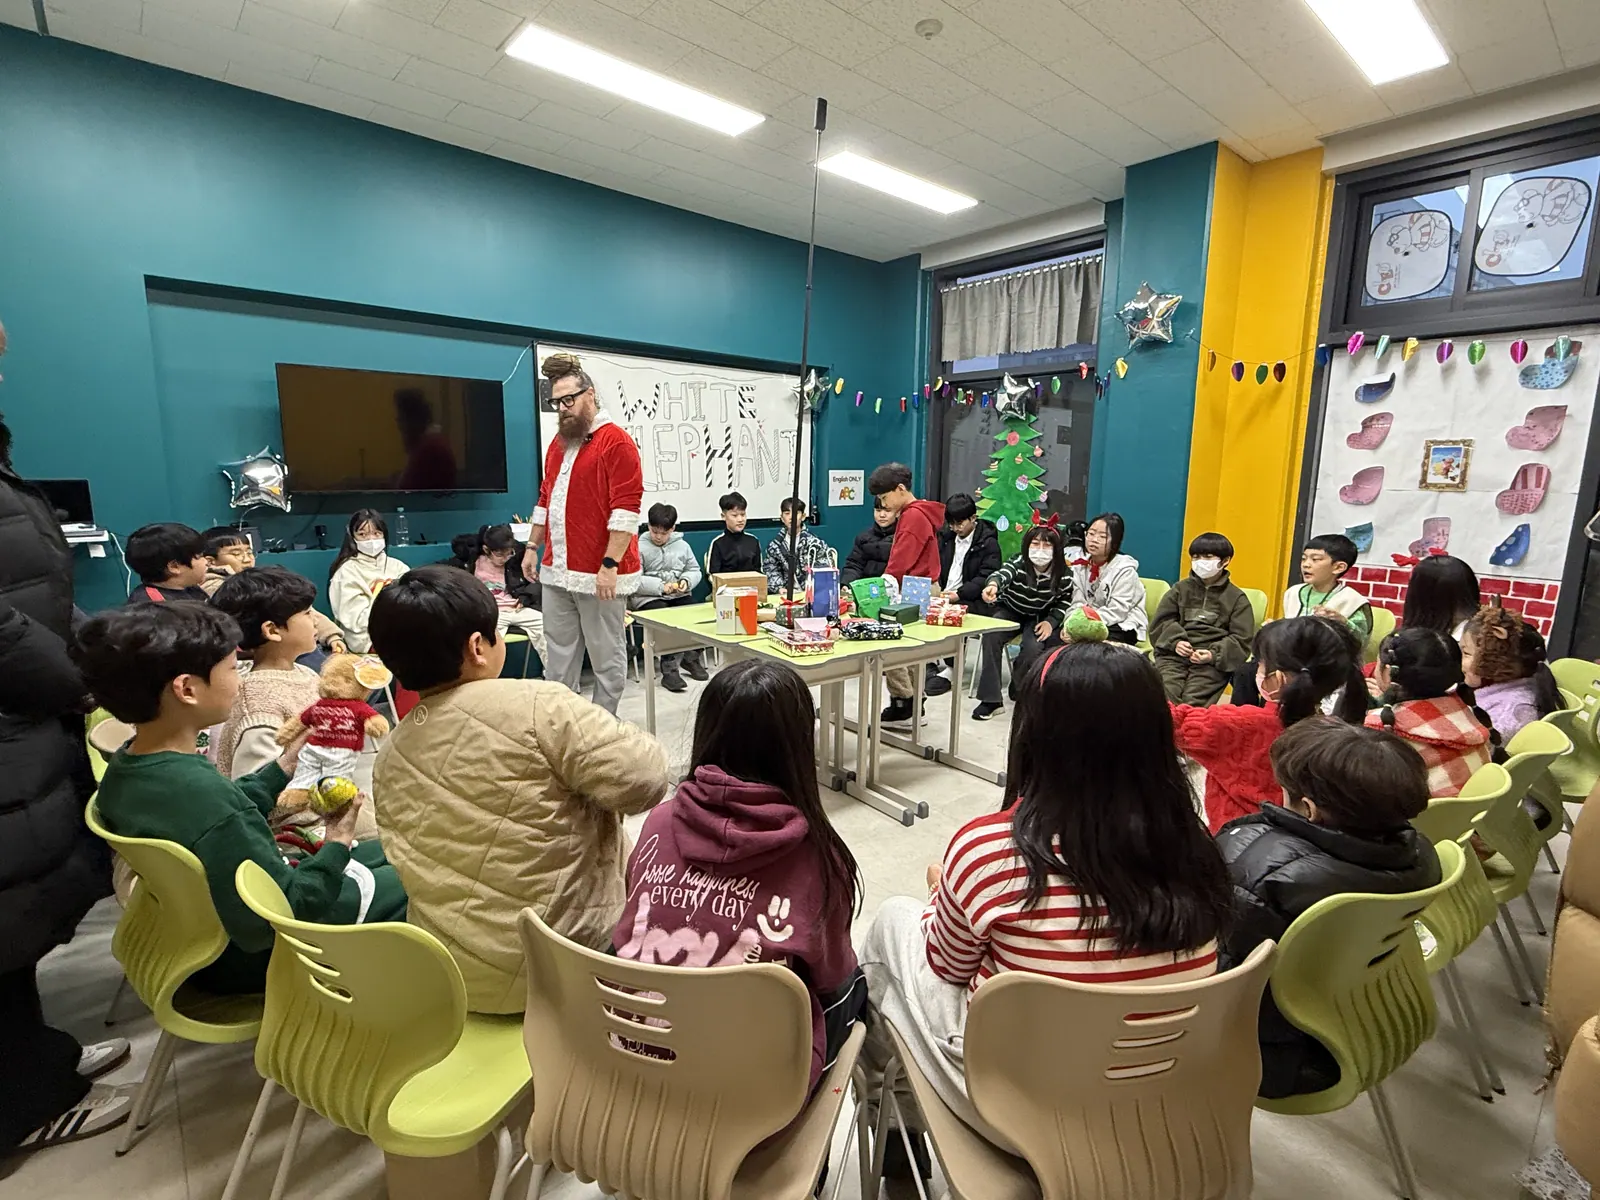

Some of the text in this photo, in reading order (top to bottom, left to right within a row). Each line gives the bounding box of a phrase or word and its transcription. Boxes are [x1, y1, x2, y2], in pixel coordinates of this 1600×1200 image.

[617, 380, 757, 423] WHITE
[621, 423, 798, 492] LEPHANT
[839, 486, 855, 500] ABC
[650, 885, 752, 931] every day
[679, 865, 760, 908] happiness
